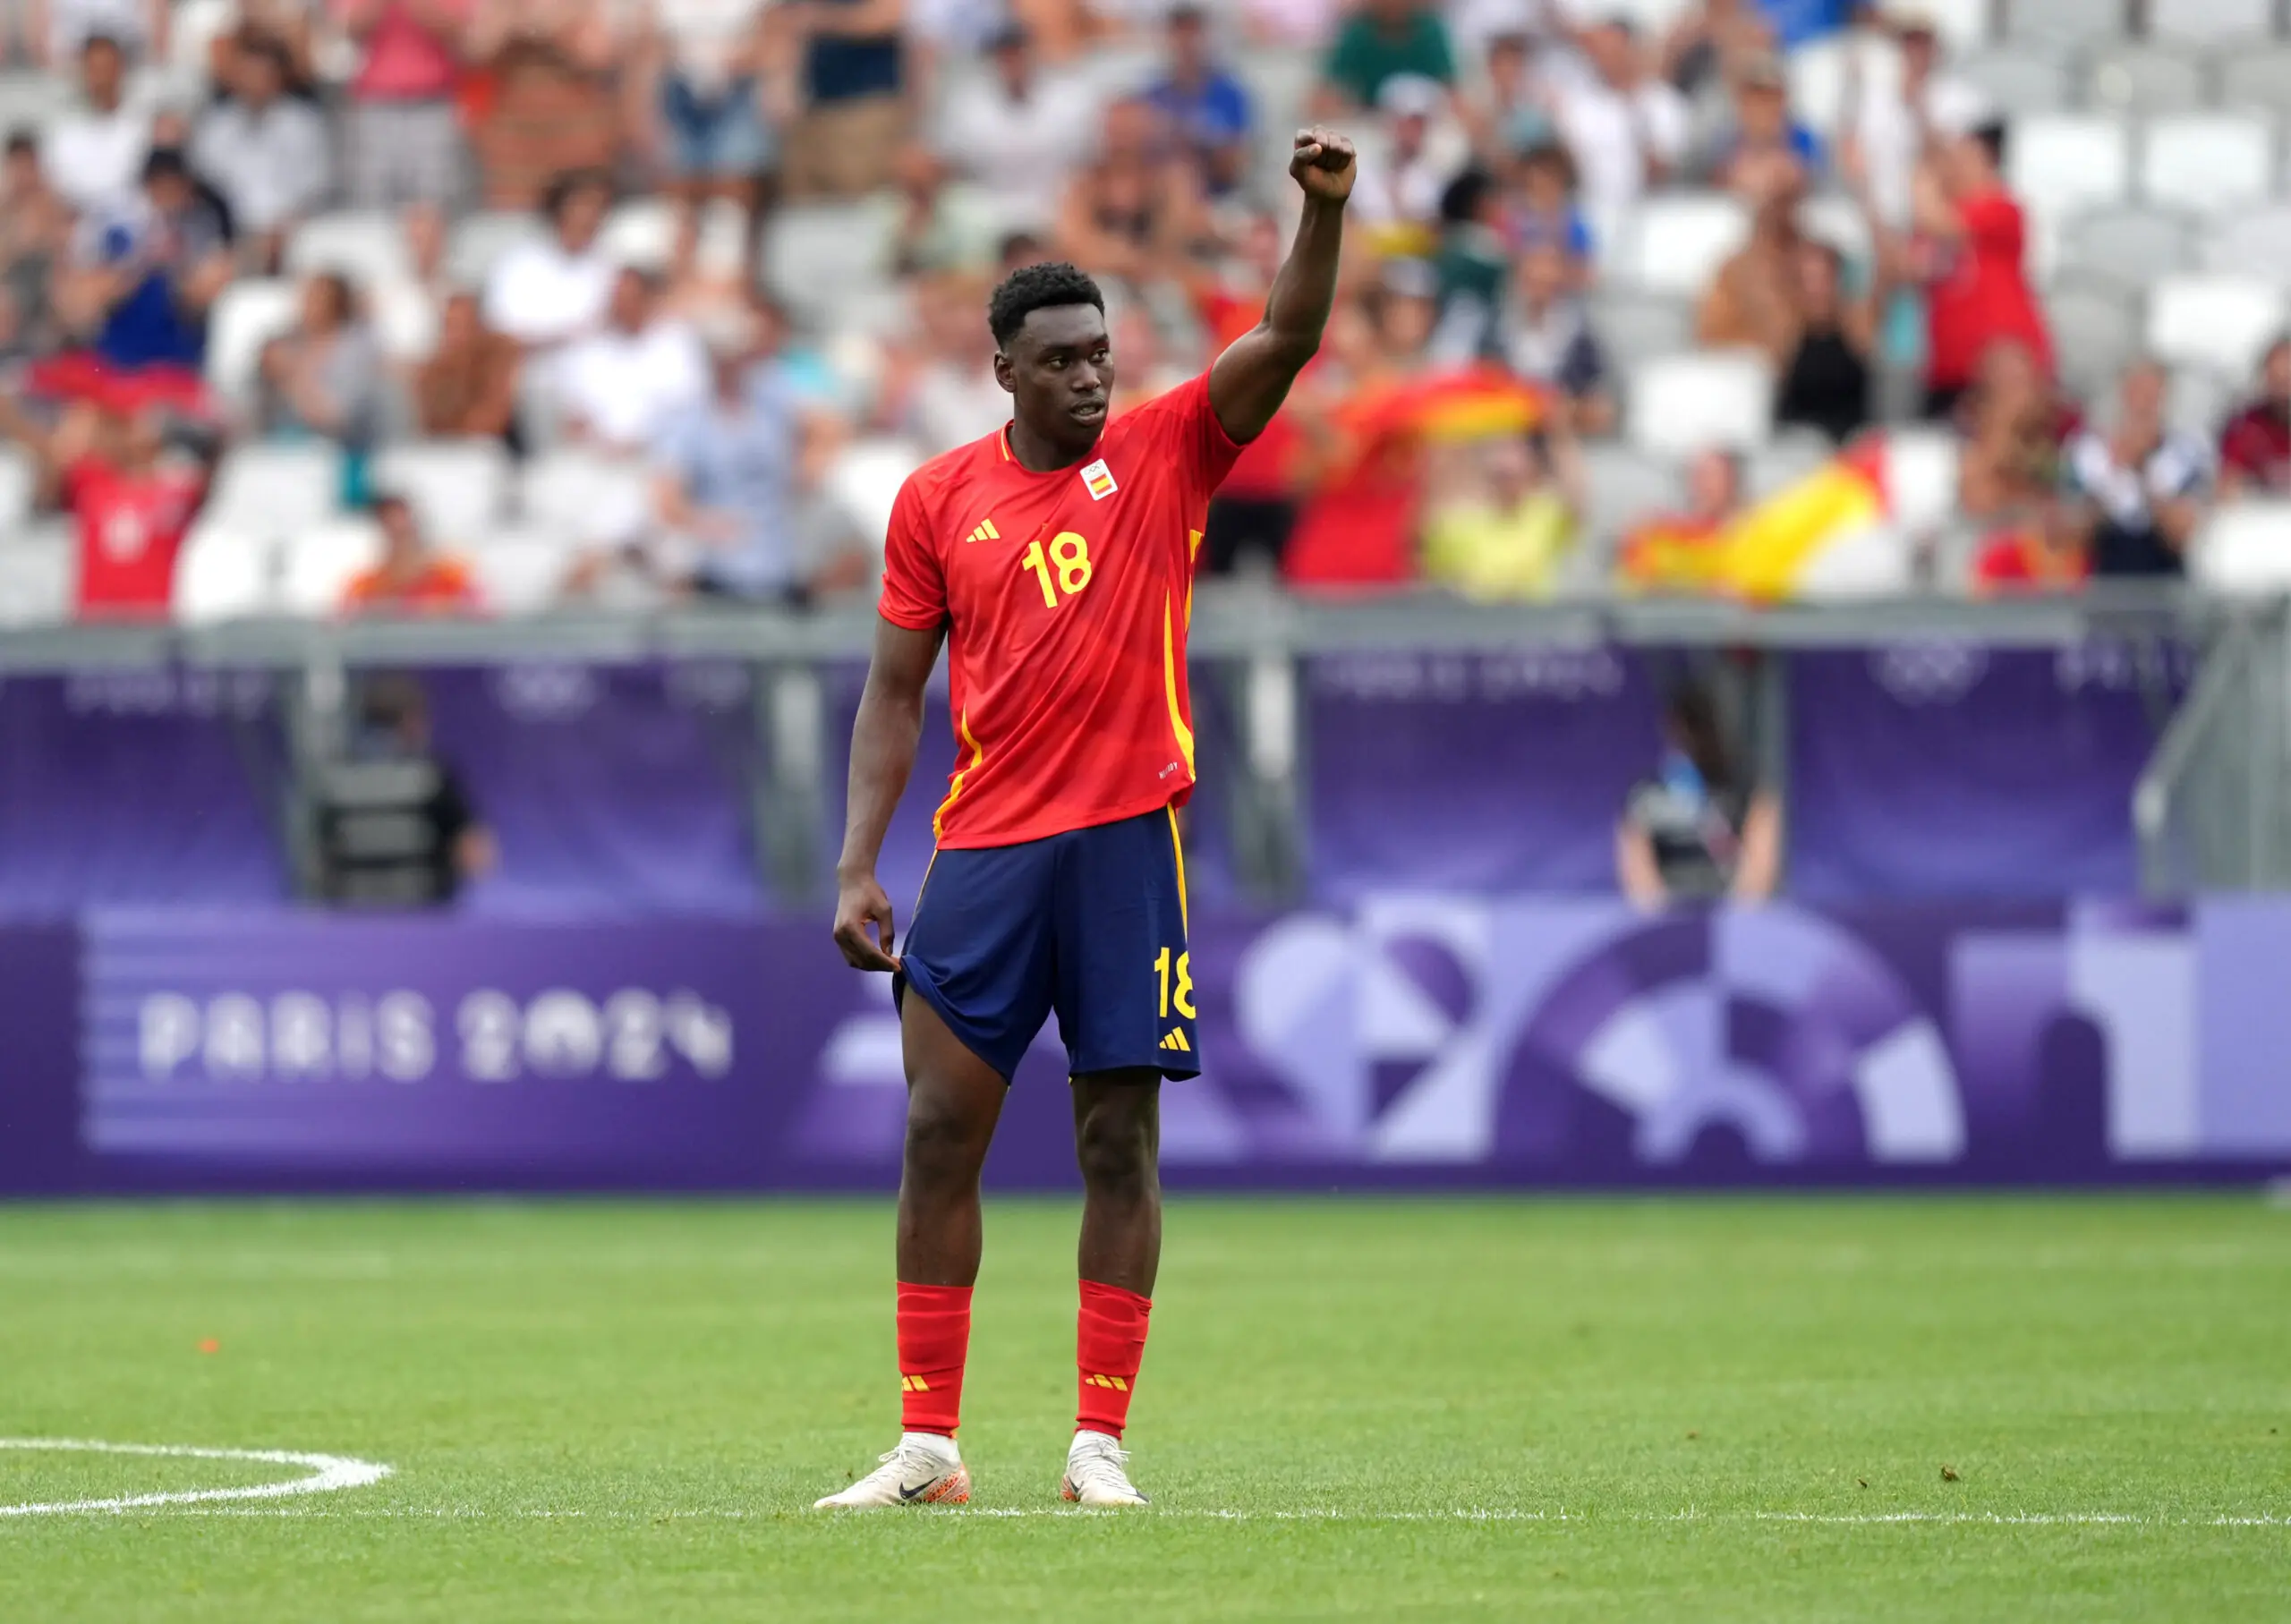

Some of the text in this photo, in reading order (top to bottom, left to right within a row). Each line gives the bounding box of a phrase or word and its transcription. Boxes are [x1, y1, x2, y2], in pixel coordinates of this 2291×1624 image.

[1022, 531, 1092, 608] 18
[1154, 947, 1197, 1019] 18
[457, 988, 733, 1081] 2024
